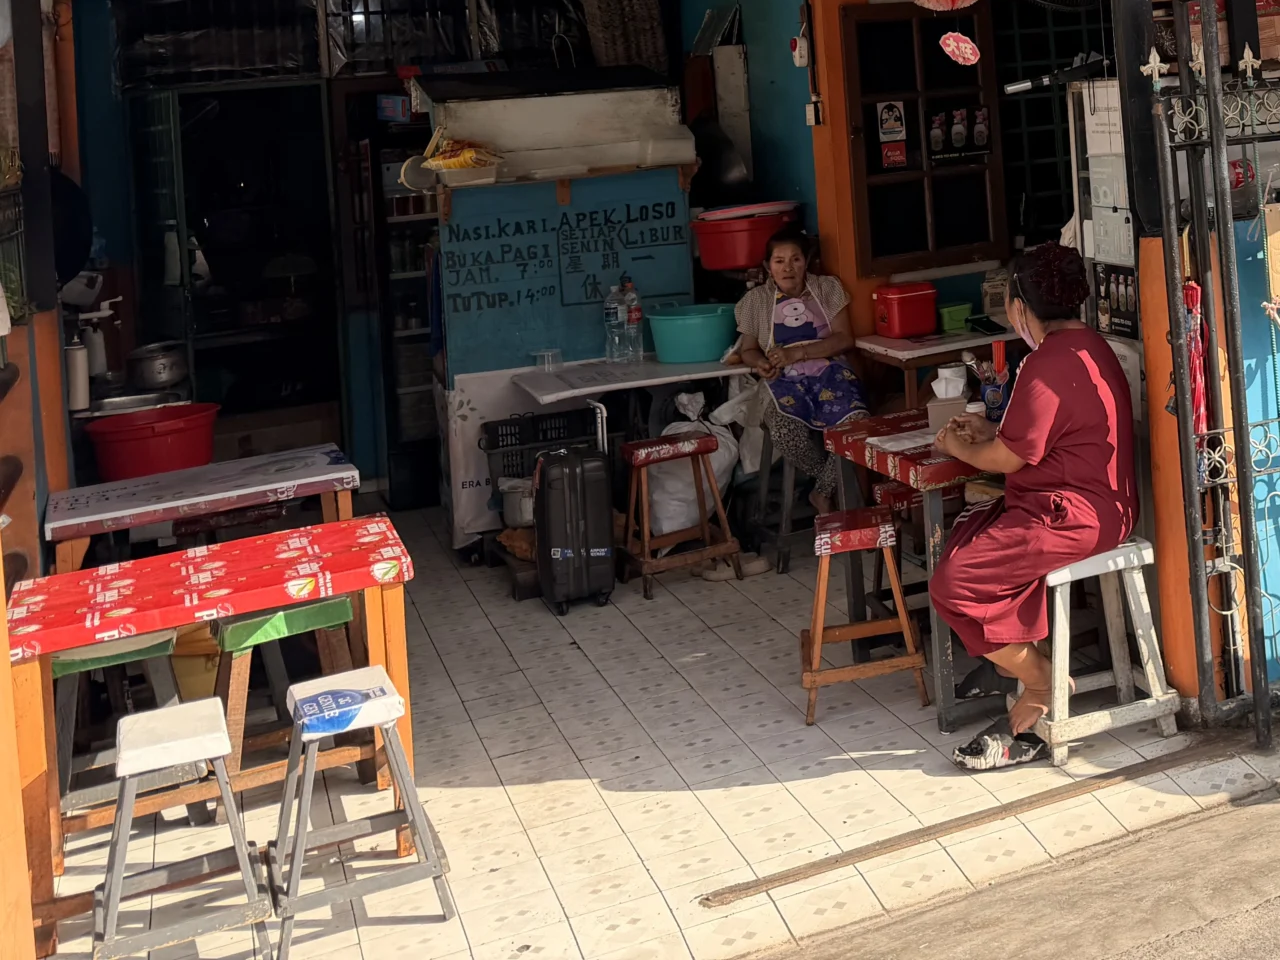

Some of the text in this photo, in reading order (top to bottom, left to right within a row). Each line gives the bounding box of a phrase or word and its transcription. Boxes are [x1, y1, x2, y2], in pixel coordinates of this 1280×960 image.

[626, 201, 675, 224] LOSO
[560, 226, 616, 241] SETIAP
[500, 243, 550, 262] PAGI
[561, 239, 614, 255] SENIN
[516, 258, 553, 280] 7:00
[462, 480, 481, 489] ERA
